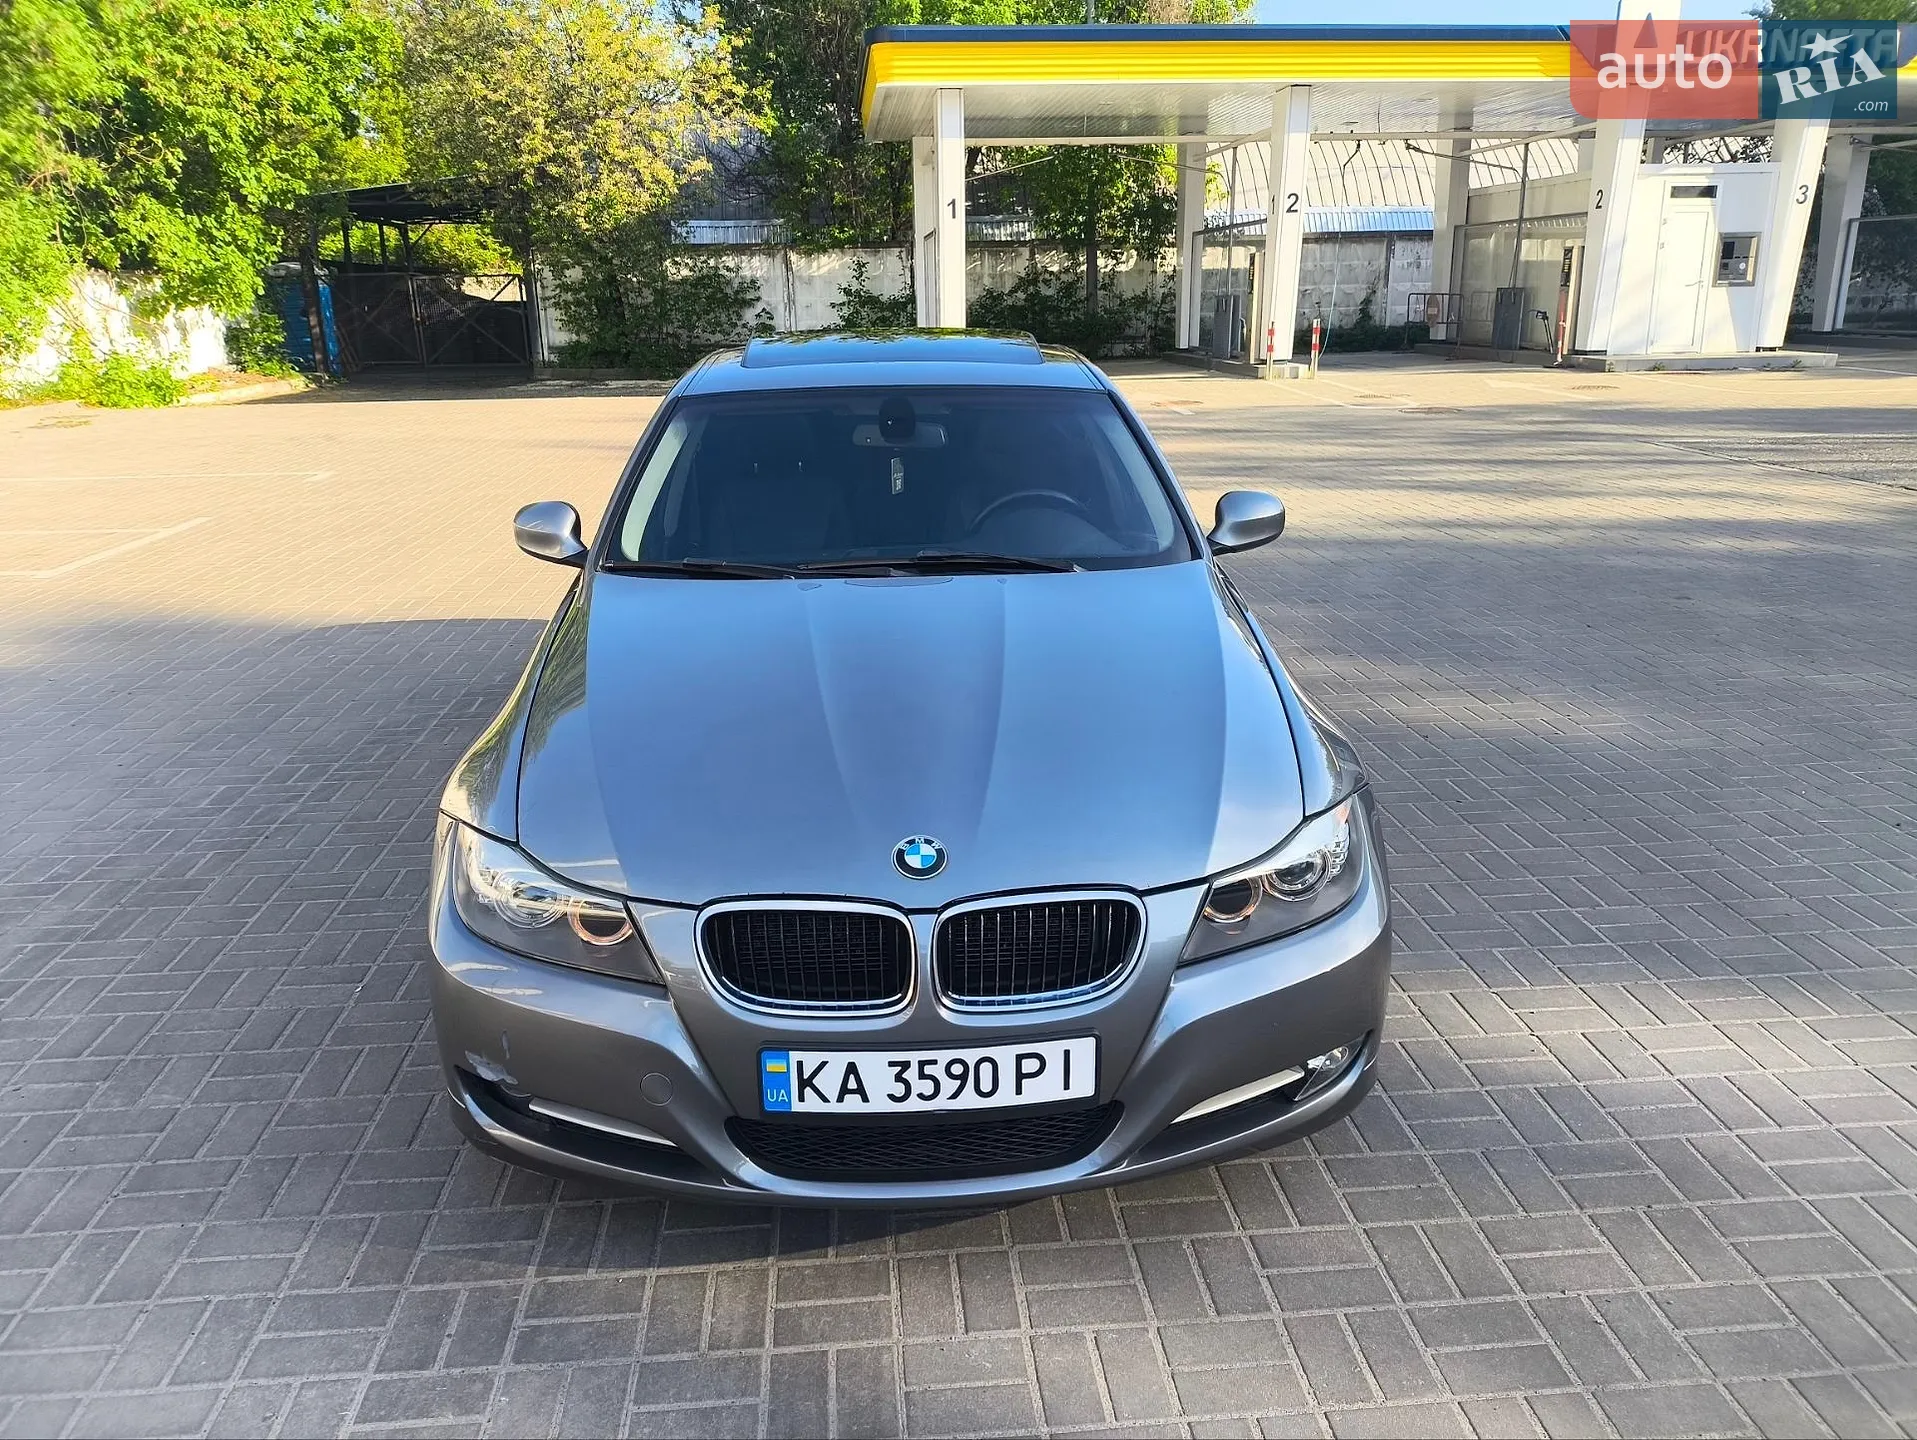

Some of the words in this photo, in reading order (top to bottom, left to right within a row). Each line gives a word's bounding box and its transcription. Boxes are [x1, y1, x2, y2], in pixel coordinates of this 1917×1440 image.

[1286, 193, 1299, 213] 2
[1595, 189, 1604, 210] 2
[1795, 184, 1809, 205] 3
[947, 198, 956, 219] 1
[899, 836, 942, 851] BMW
[796, 1060, 870, 1103] KA
[886, 1055, 999, 1103] 3590
[767, 1088, 789, 1103] UA
